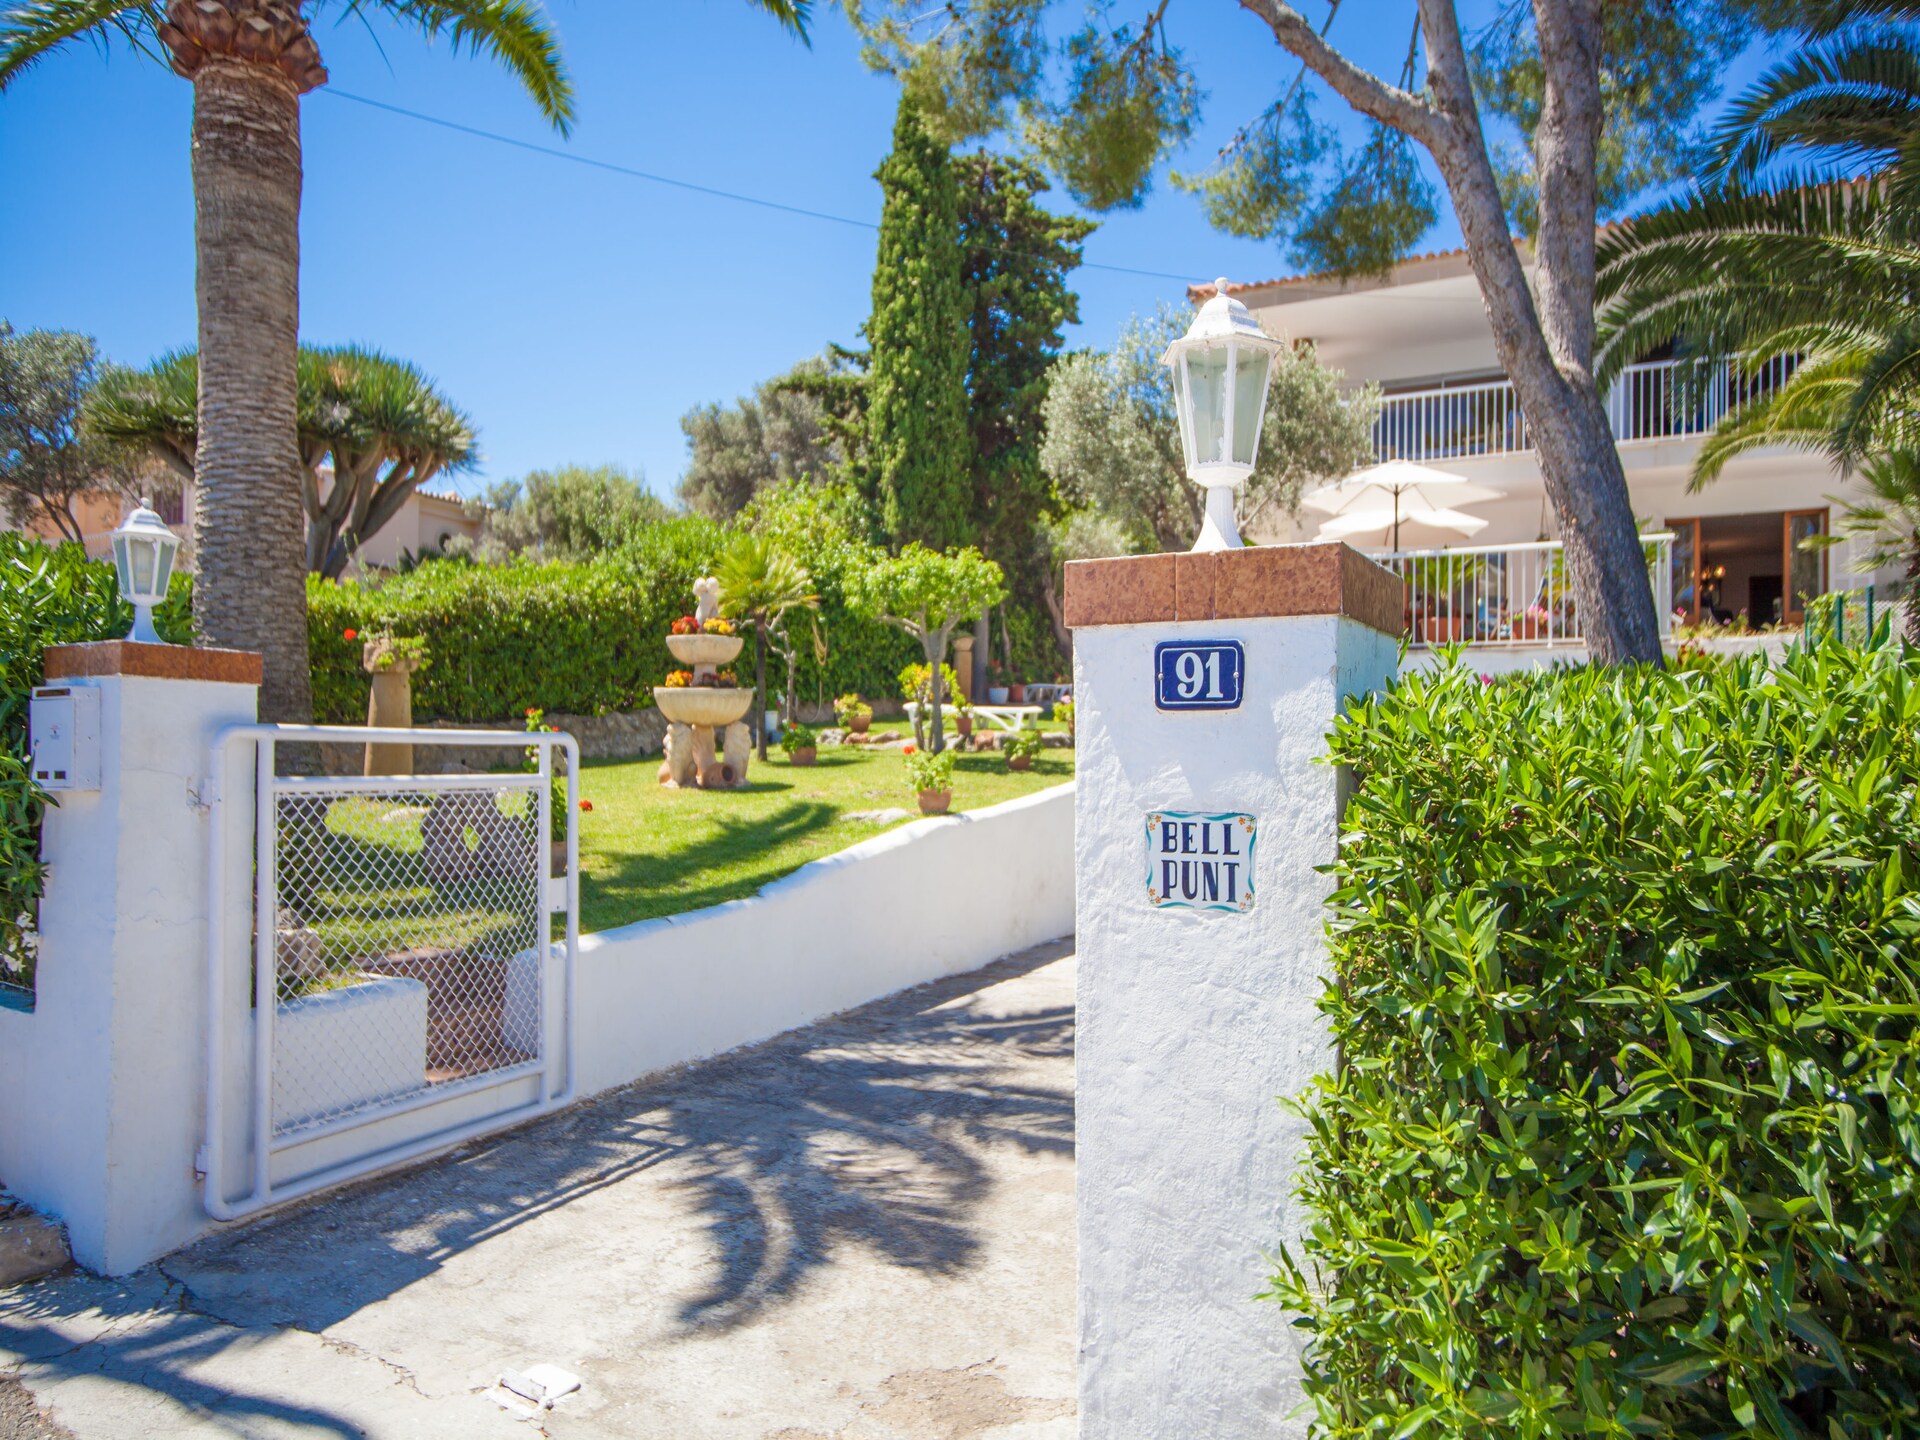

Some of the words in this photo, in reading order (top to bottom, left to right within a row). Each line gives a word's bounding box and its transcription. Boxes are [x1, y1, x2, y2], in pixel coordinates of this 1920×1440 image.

[1175, 651, 1224, 699] 91
[1160, 821, 1240, 856] BELL
[1160, 859, 1240, 903] PUNT
